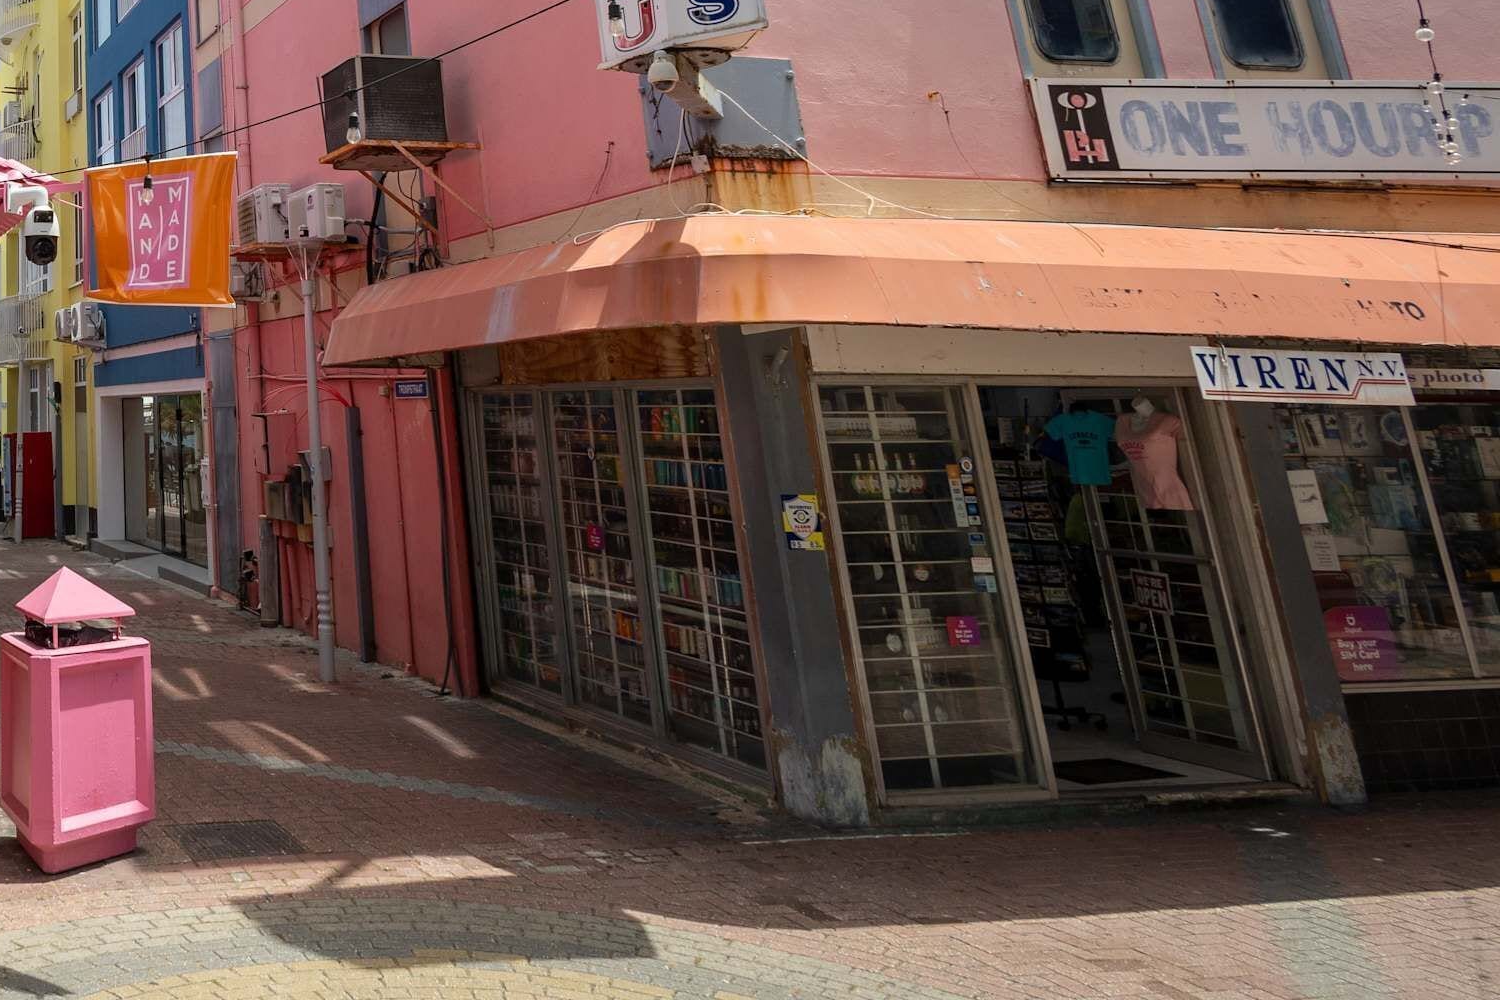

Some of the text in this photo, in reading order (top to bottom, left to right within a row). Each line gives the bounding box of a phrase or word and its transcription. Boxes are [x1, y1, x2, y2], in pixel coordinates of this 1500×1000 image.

[1119, 99, 1248, 158] ONE
[1266, 101, 1440, 159] HOUR
[166, 185, 183, 278] MADE
[1195, 353, 1404, 392] VIREN N.V.
[1422, 370, 1485, 388] photo
[1135, 586, 1168, 610] OPEN
[1336, 638, 1377, 650] Buy your
[1339, 649, 1381, 660] SIM Card
[1352, 662, 1374, 672] here
